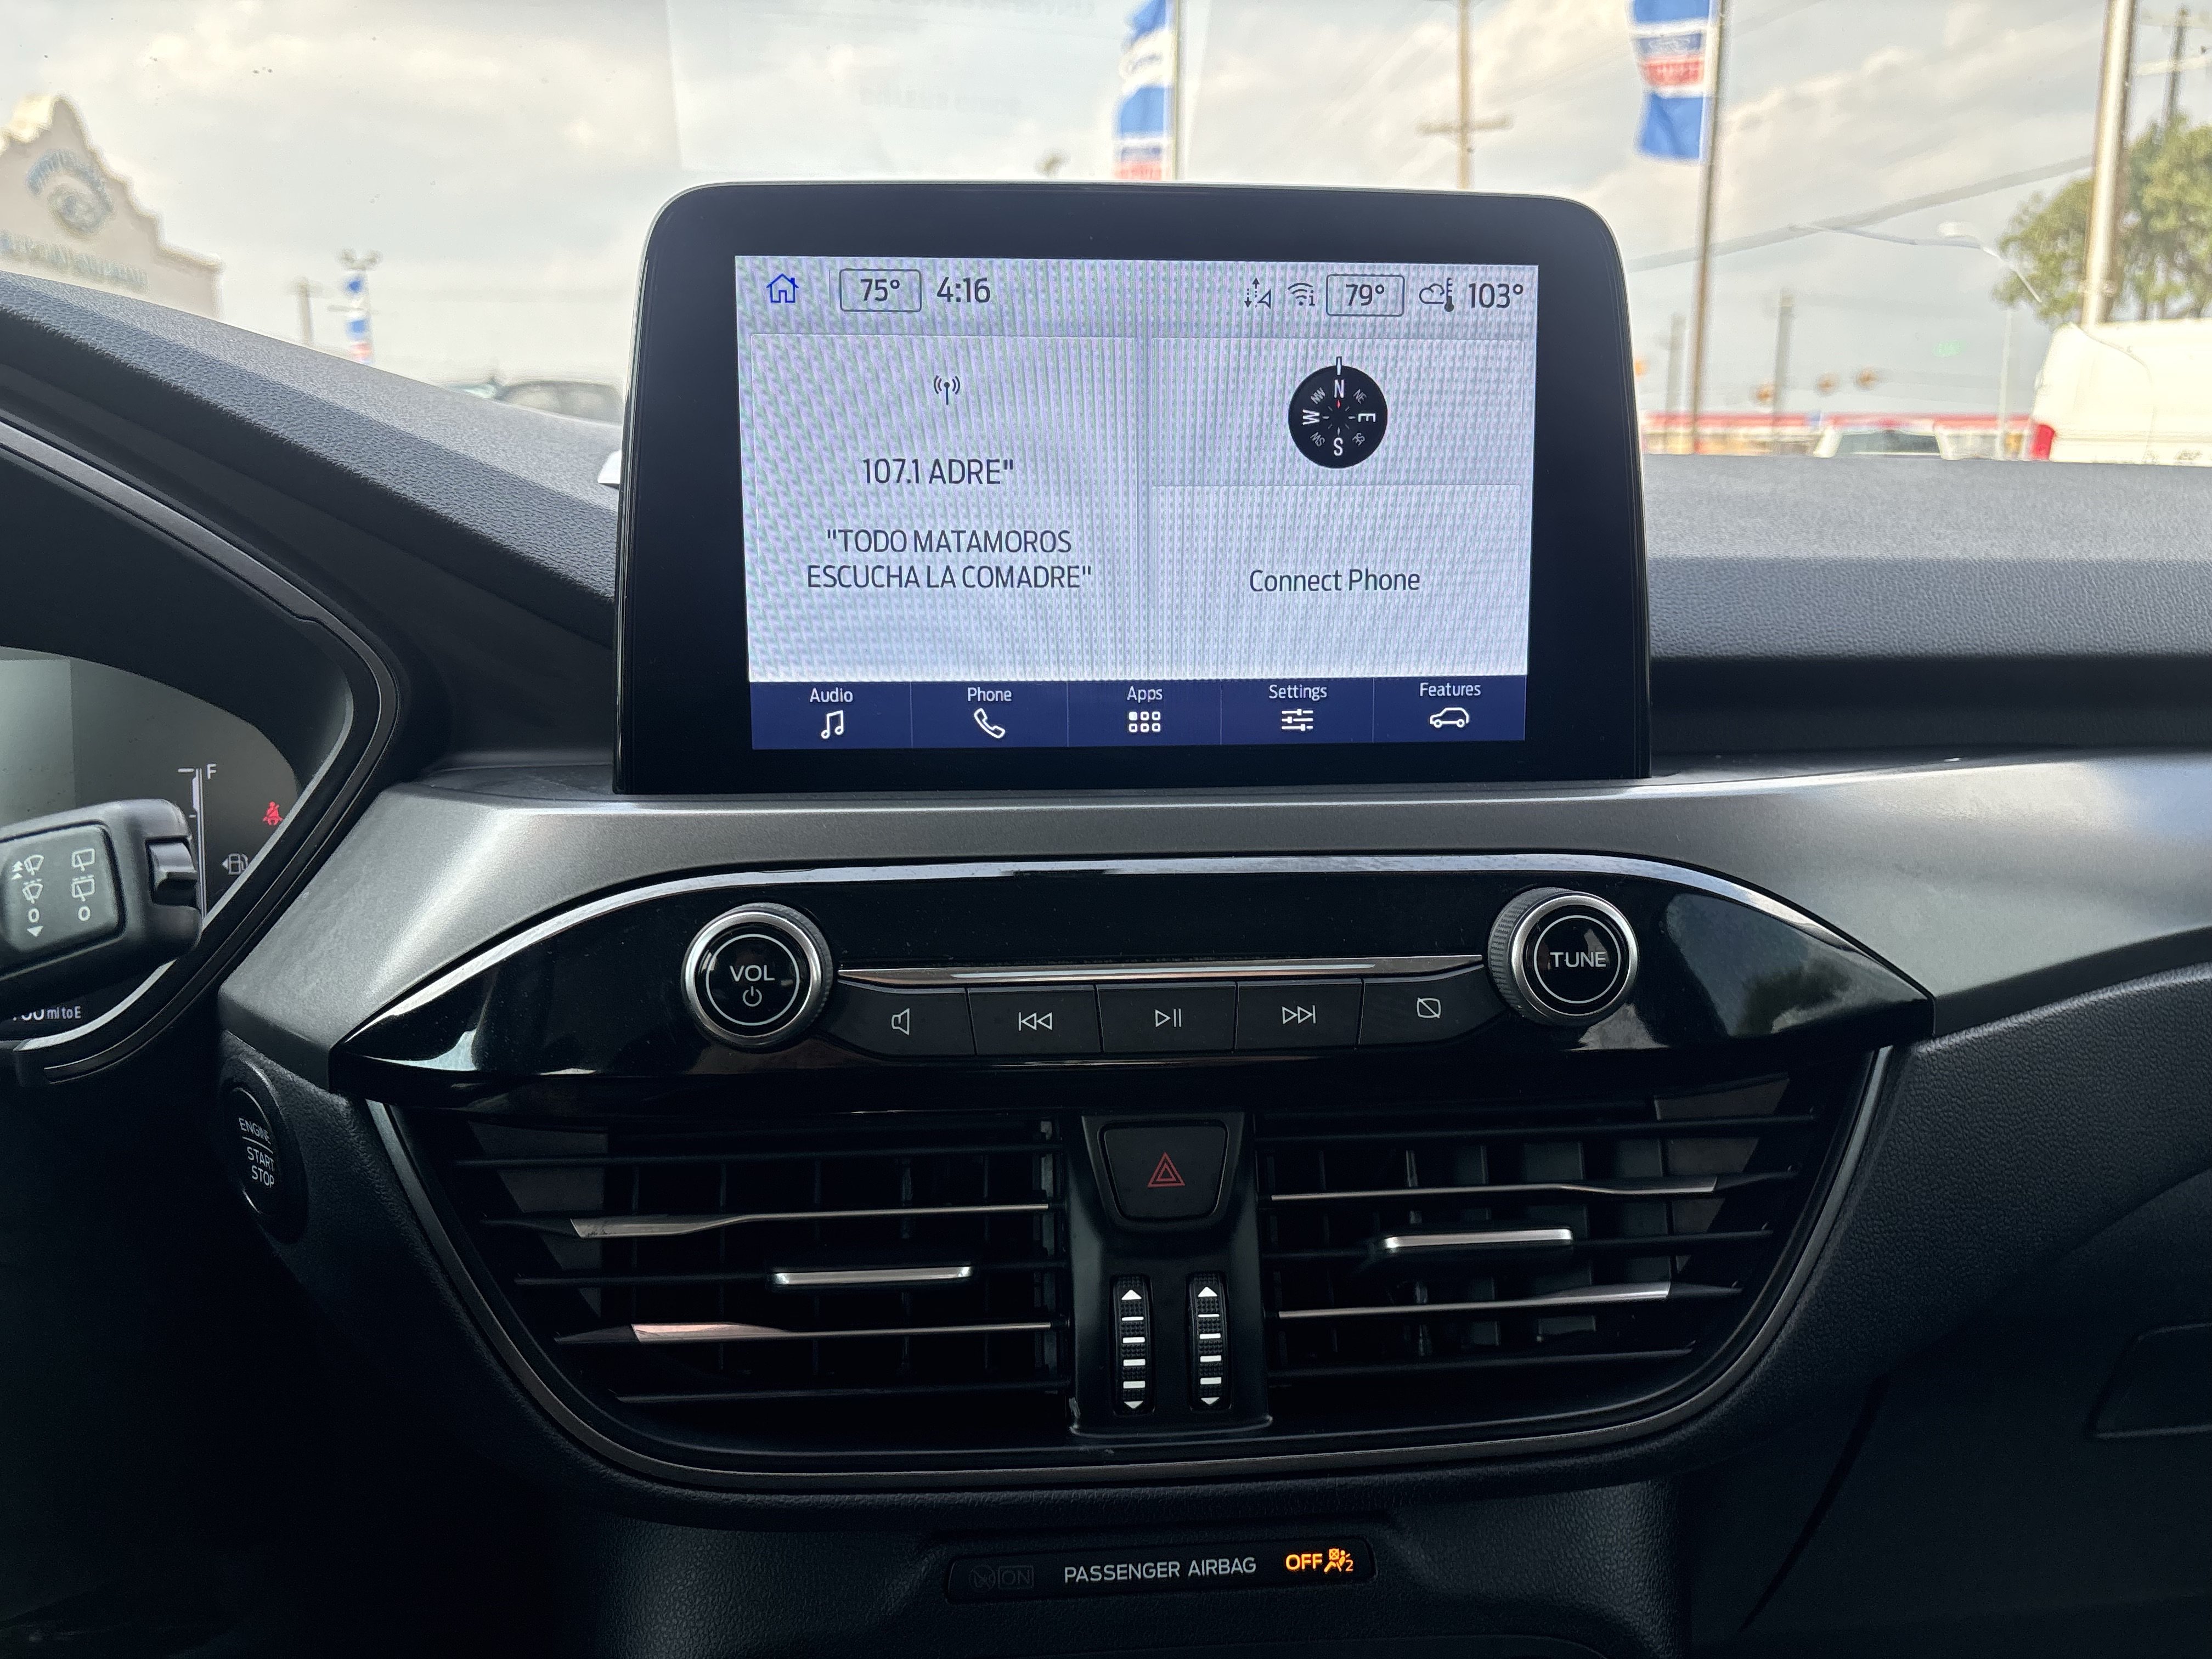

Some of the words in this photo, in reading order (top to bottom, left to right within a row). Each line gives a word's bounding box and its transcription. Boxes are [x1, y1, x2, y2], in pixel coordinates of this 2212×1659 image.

[860, 278, 900, 302] 75°
[936, 276, 990, 303] 4:16
[1345, 284, 1385, 307] 79°
[1468, 283, 1523, 308] 103°
[1334, 380, 1344, 398] N
[1353, 389, 1367, 404] NE
[1302, 409, 1320, 425] W
[1358, 413, 1375, 422] E
[1333, 438, 1343, 456] S
[862, 458, 919, 485] 107.1
[929, 459, 1013, 485] ADRE"
[827, 529, 907, 553] "TODO
[914, 529, 1071, 553] MATAMOROS
[808, 565, 924, 589] ESCUCHA
[927, 565, 957, 588] LA
[962, 565, 1092, 588] COMADRE"
[1250, 569, 1341, 592] Connect
[1349, 568, 1420, 591] Phone
[810, 687, 854, 703] Audio
[967, 686, 1012, 703] Phone
[1127, 686, 1163, 706] Apps
[1268, 683, 1328, 703] Settings
[1419, 681, 1482, 698] Features
[207, 763, 217, 778] F
[1550, 951, 1606, 968] TUNE
[730, 965, 775, 981] VOL
[61, 1007, 74, 1019] to
[75, 1006, 81, 1019] E
[239, 1117, 272, 1144] ENGINE
[247, 1147, 274, 1171] START
[251, 1165, 275, 1188] STOP
[1064, 1562, 1180, 1583] PASSENGER
[1188, 1557, 1256, 1576] AIRBAG
[1286, 1553, 1323, 1570] OFF
